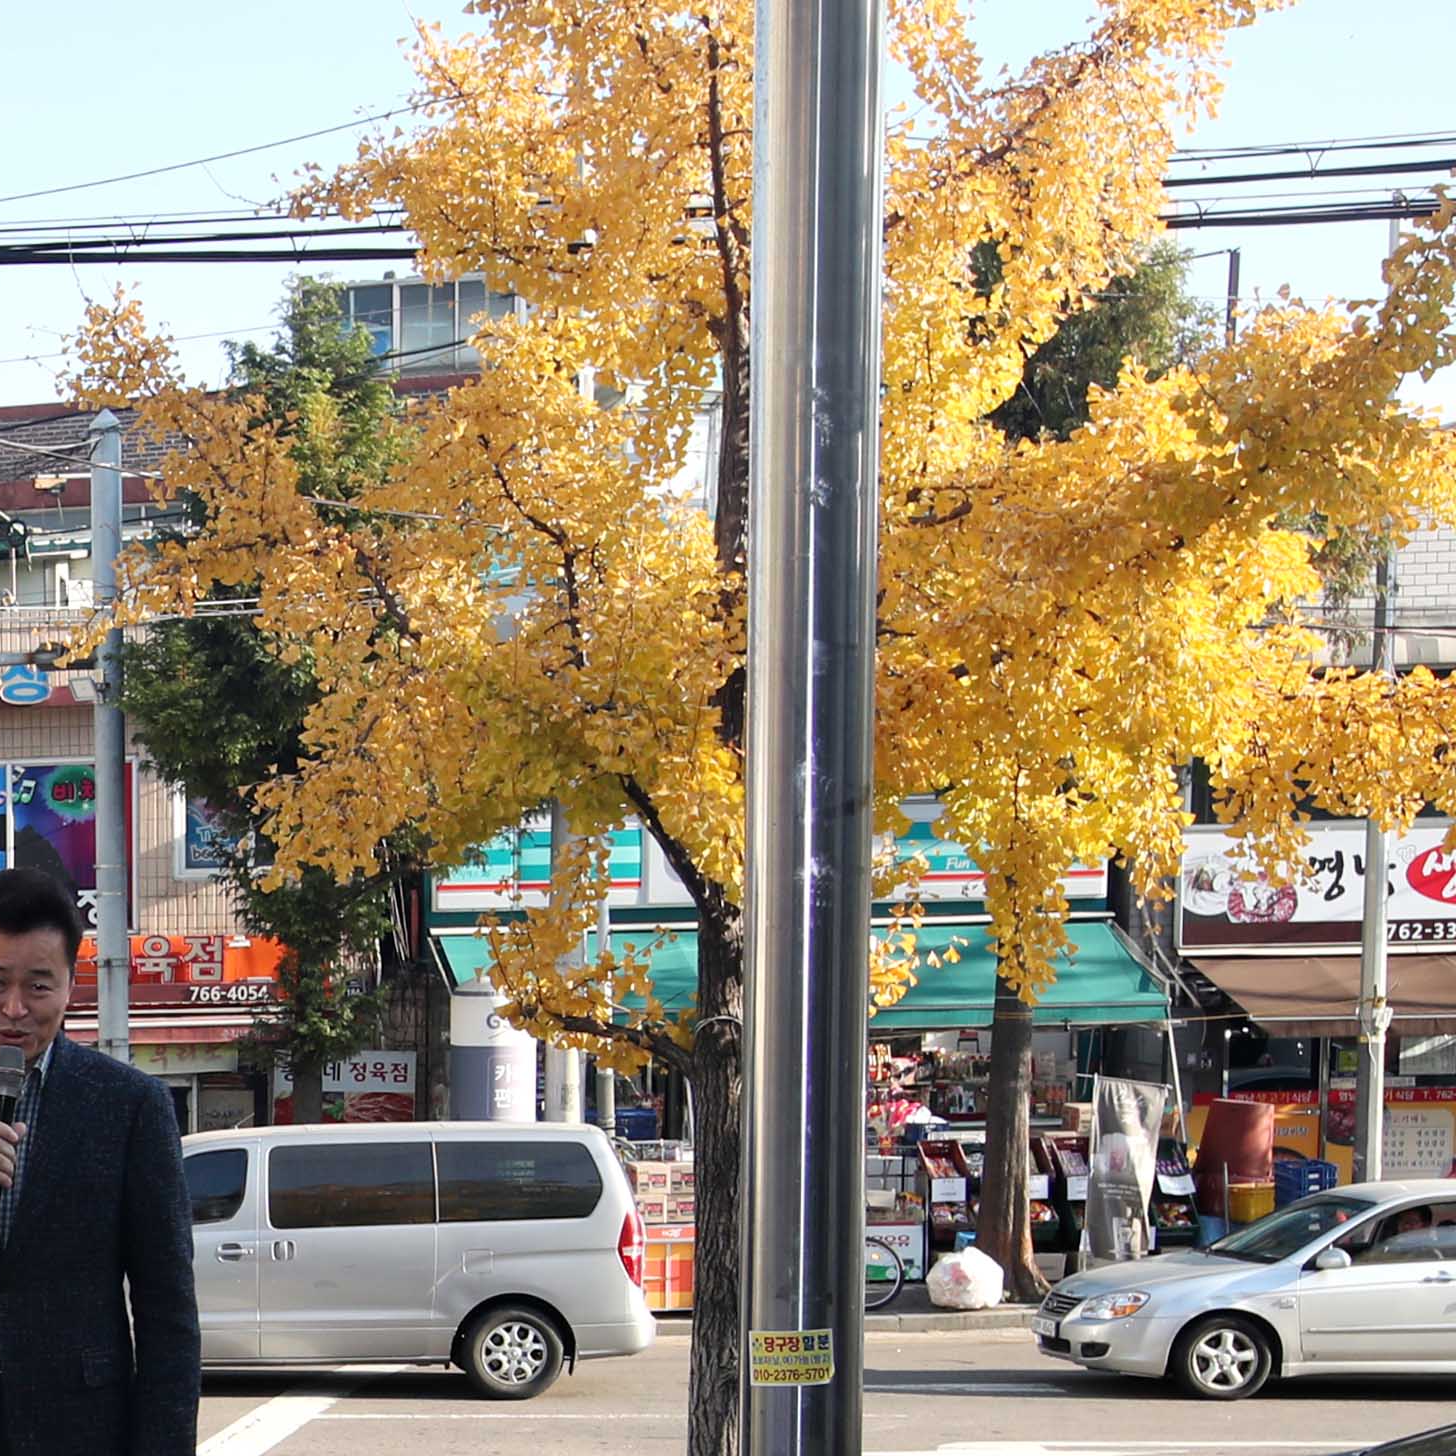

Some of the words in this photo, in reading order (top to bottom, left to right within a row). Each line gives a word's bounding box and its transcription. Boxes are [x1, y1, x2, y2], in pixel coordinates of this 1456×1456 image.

[189, 985, 269, 1001] 766-4054
[349, 1061, 409, 1083] 정육점
[763, 1335, 801, 1353] 당구장
[752, 1367, 830, 1382] 010-2376-5701
